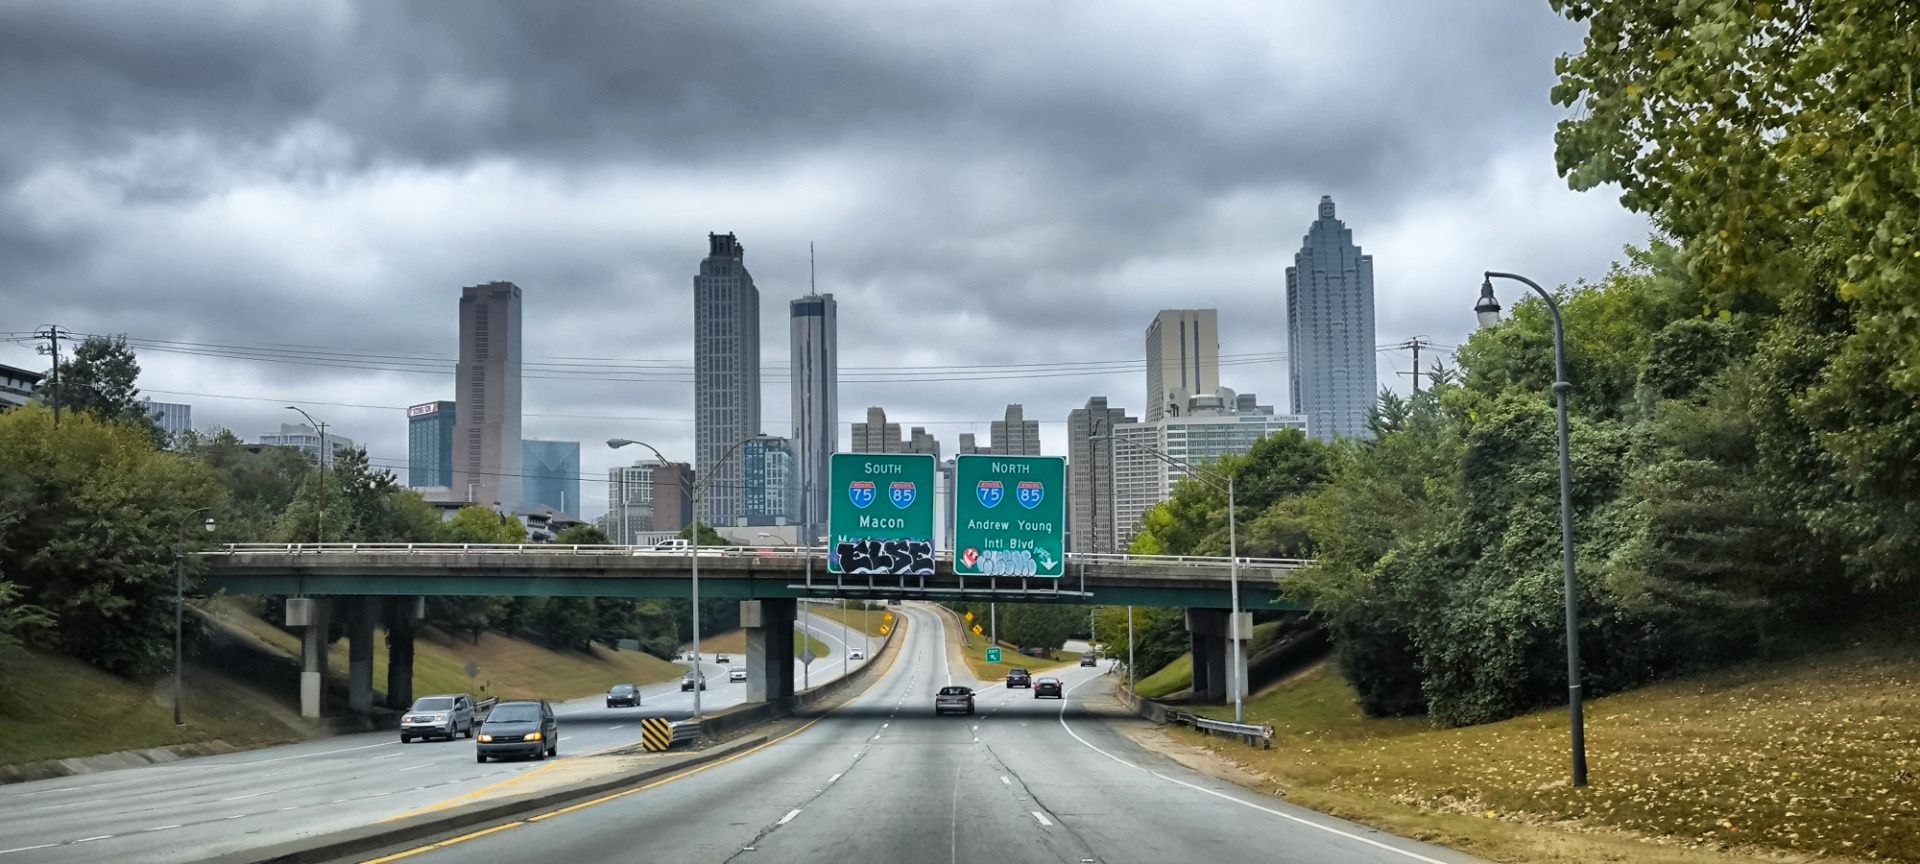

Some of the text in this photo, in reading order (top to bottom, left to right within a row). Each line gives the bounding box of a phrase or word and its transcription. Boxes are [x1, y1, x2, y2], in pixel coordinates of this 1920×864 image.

[864, 462, 902, 474] SOUTH
[992, 462, 1030, 474] NORTH
[853, 488, 912, 501] 75 85
[980, 488, 1040, 501] 75 85
[859, 515, 905, 528] Macon
[968, 519, 1052, 534] Andrew Young
[984, 538, 1034, 549] Intl Blvd
[836, 540, 935, 574] ELSE
